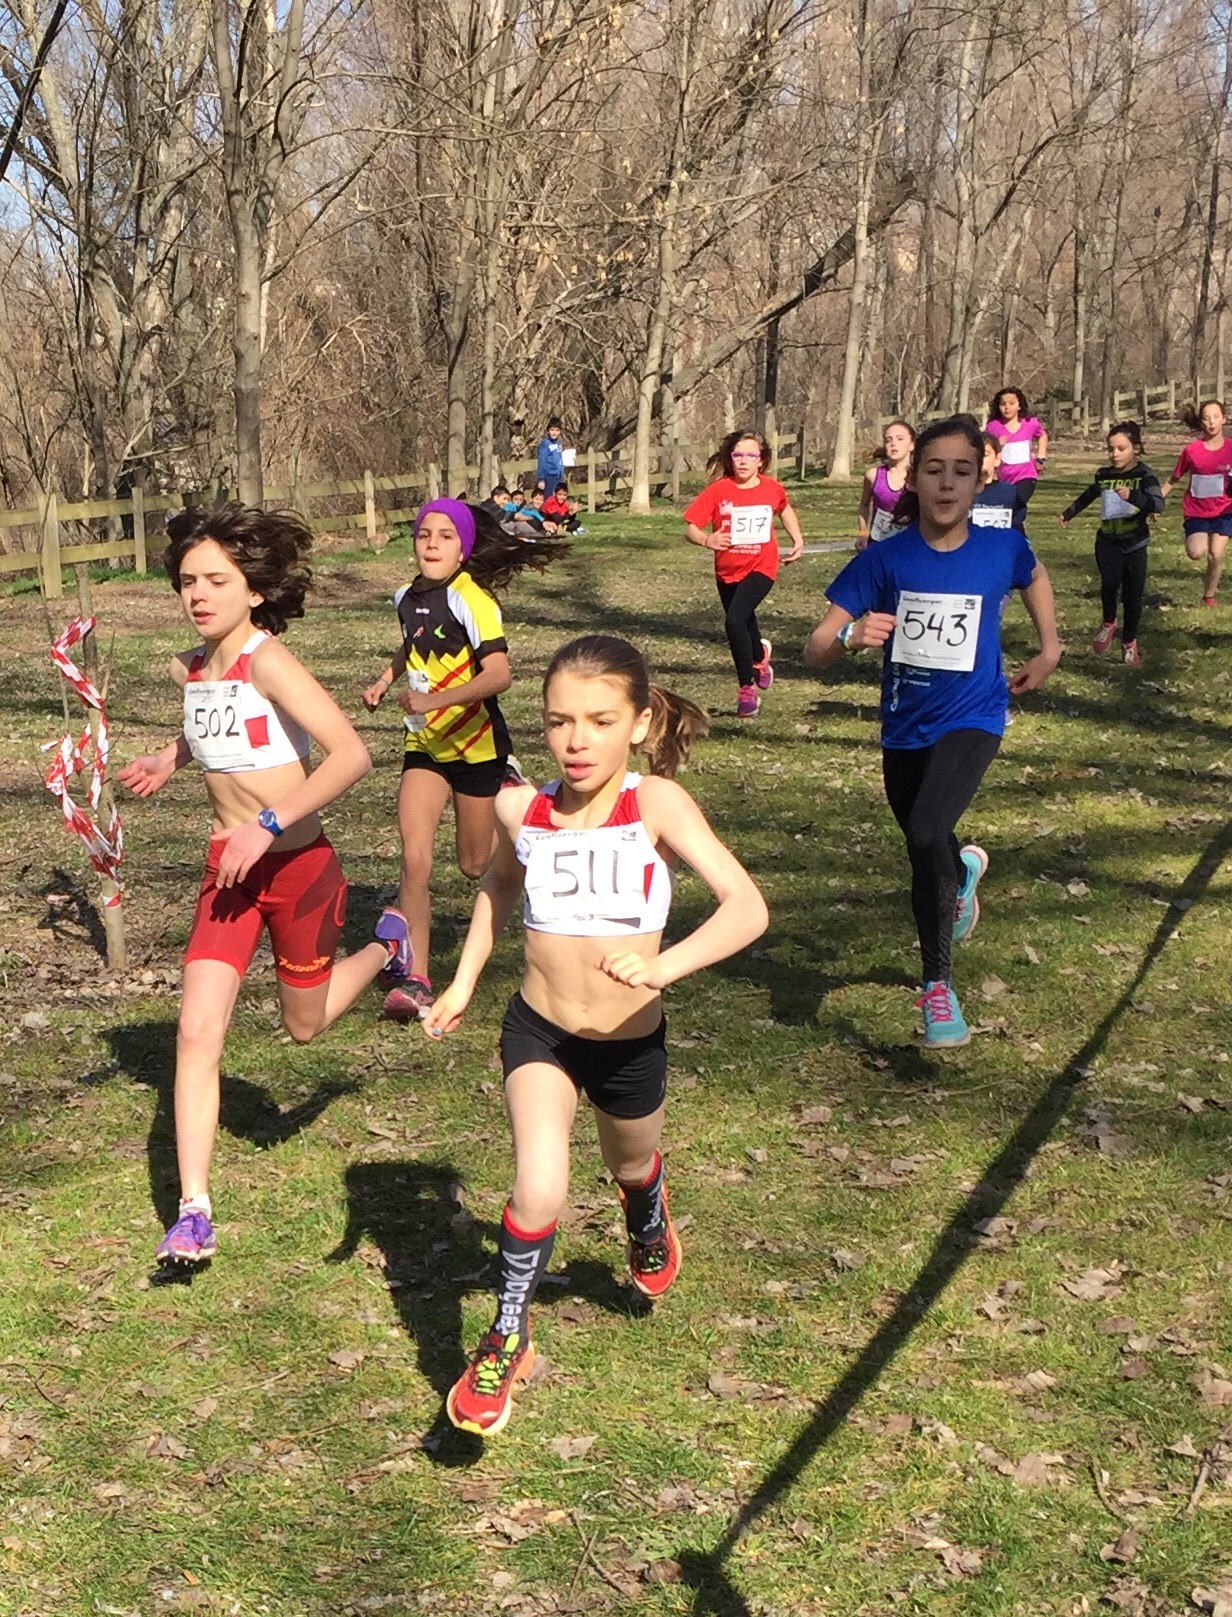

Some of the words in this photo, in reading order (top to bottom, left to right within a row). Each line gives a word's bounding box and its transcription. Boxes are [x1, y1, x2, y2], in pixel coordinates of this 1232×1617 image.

[1099, 477, 1142, 490] ETROIT
[736, 517, 768, 533] 517
[902, 610, 967, 647] 543
[195, 705, 240, 739] 502
[552, 850, 620, 898] 511
